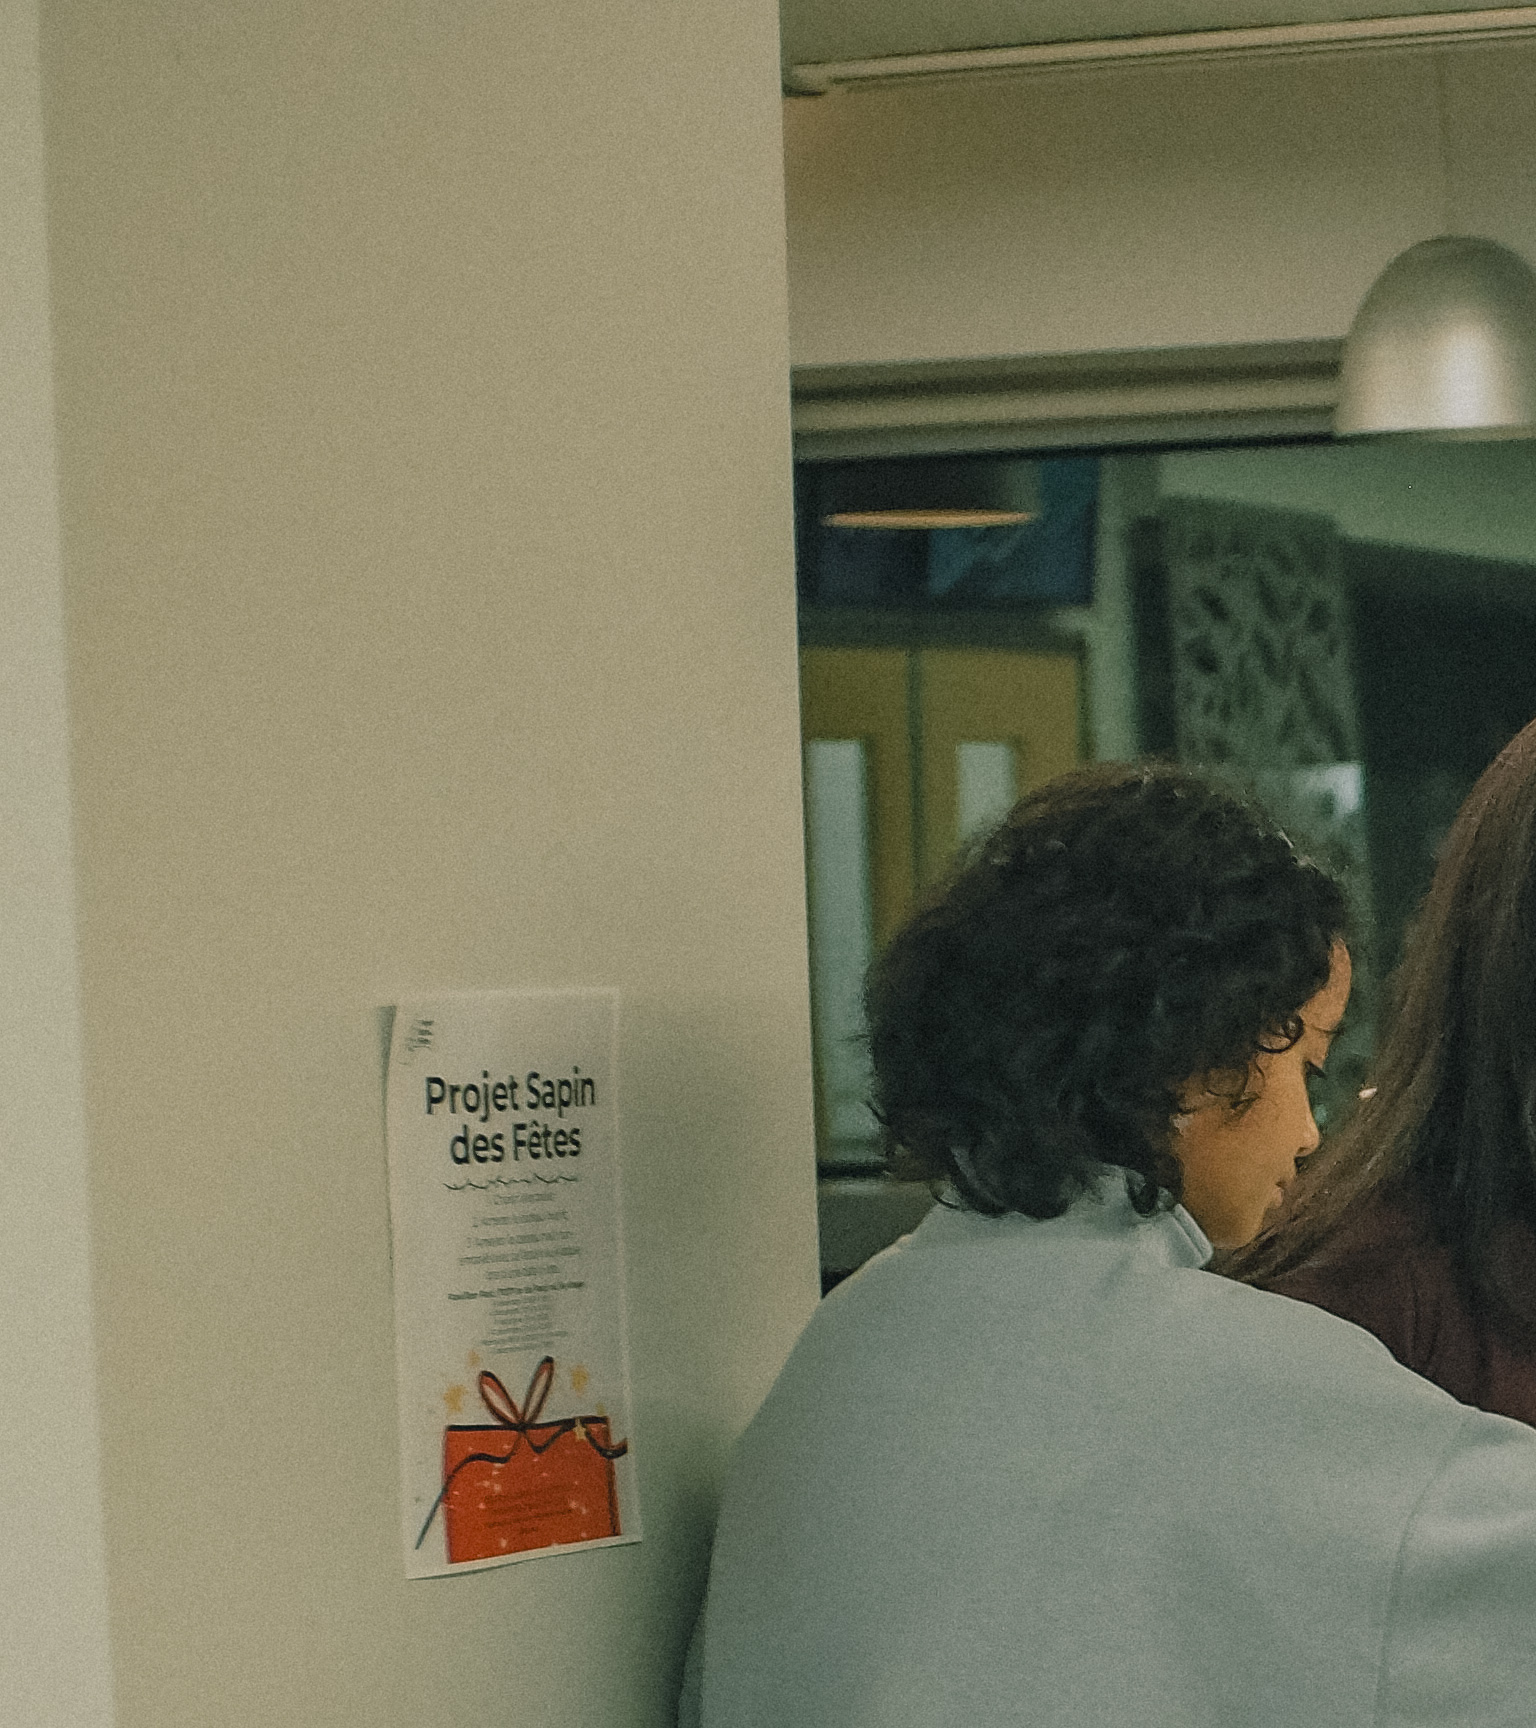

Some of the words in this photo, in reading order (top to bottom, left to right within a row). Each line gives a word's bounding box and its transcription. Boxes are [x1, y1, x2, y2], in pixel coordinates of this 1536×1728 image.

[425, 1069, 519, 1123] Projet
[526, 1065, 595, 1119] Sapin
[450, 1123, 505, 1165] des
[512, 1119, 581, 1161] Fêtes
